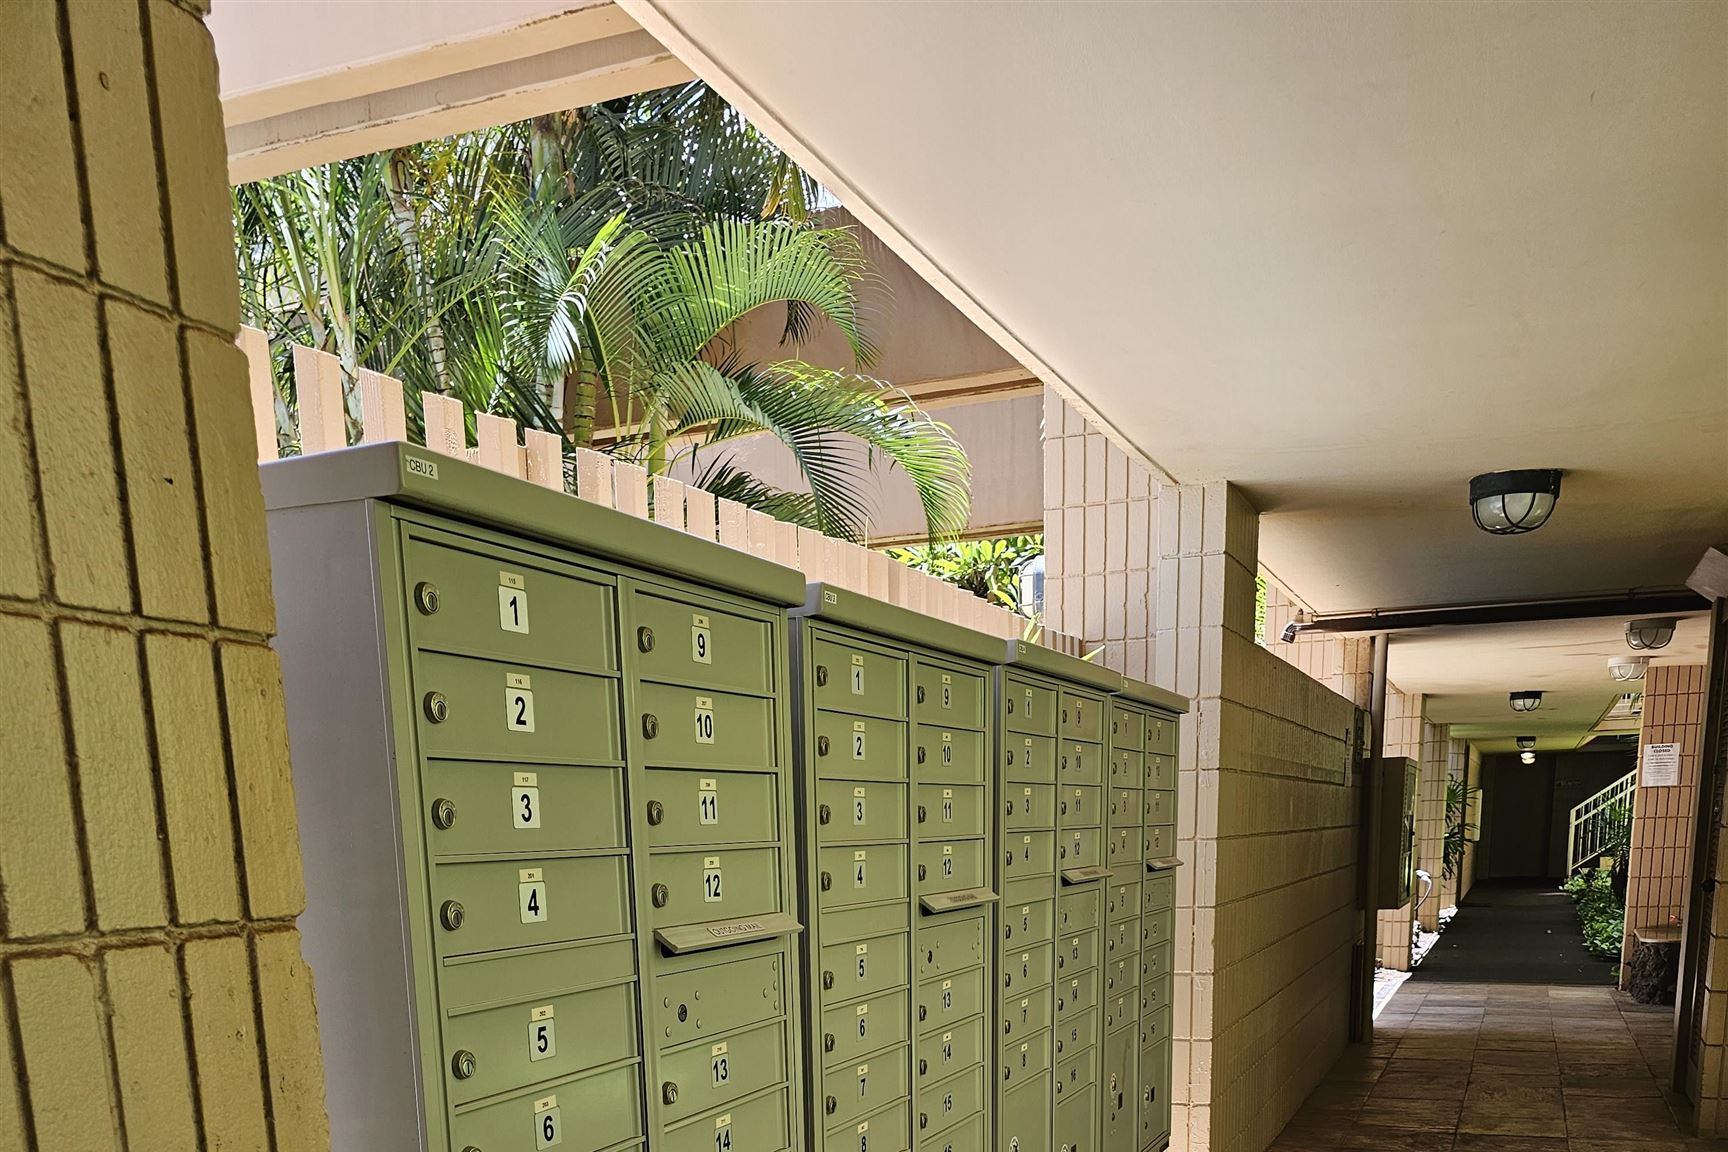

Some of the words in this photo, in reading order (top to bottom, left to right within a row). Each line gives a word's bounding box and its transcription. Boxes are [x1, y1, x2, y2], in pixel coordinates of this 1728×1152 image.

[409, 459, 427, 474] CBU
[429, 465, 435, 477] 2
[509, 596, 519, 626] 1
[697, 633, 706, 658] 9
[855, 670, 860, 691] 1
[944, 688, 949, 706] 9
[514, 696, 527, 726] 2
[696, 713, 713, 738] 10
[856, 736, 862, 756] 2
[943, 745, 951, 763] 10
[1026, 749, 1030, 765] 2
[520, 793, 533, 822] 3
[701, 796, 716, 820] 11
[856, 801, 863, 821] 3
[944, 802, 951, 820] 11
[1025, 798, 1030, 814] 3
[1024, 847, 1029, 862] 4
[857, 865, 863, 885] 4
[944, 858, 952, 876] 12
[705, 874, 721, 897] 12
[527, 888, 540, 917] 4
[1023, 917, 1028, 932] 5
[859, 958, 865, 978] 5
[1023, 964, 1028, 978] 6
[943, 992, 951, 1009] 13
[1023, 1008, 1027, 1023] 7
[860, 1018, 865, 1037] 6
[537, 1025, 548, 1053] 5
[943, 1043, 951, 1062] 14
[712, 1058, 728, 1082] 13
[860, 1077, 866, 1097] 7
[944, 1094, 952, 1113] 15
[543, 1115, 554, 1142] 6
